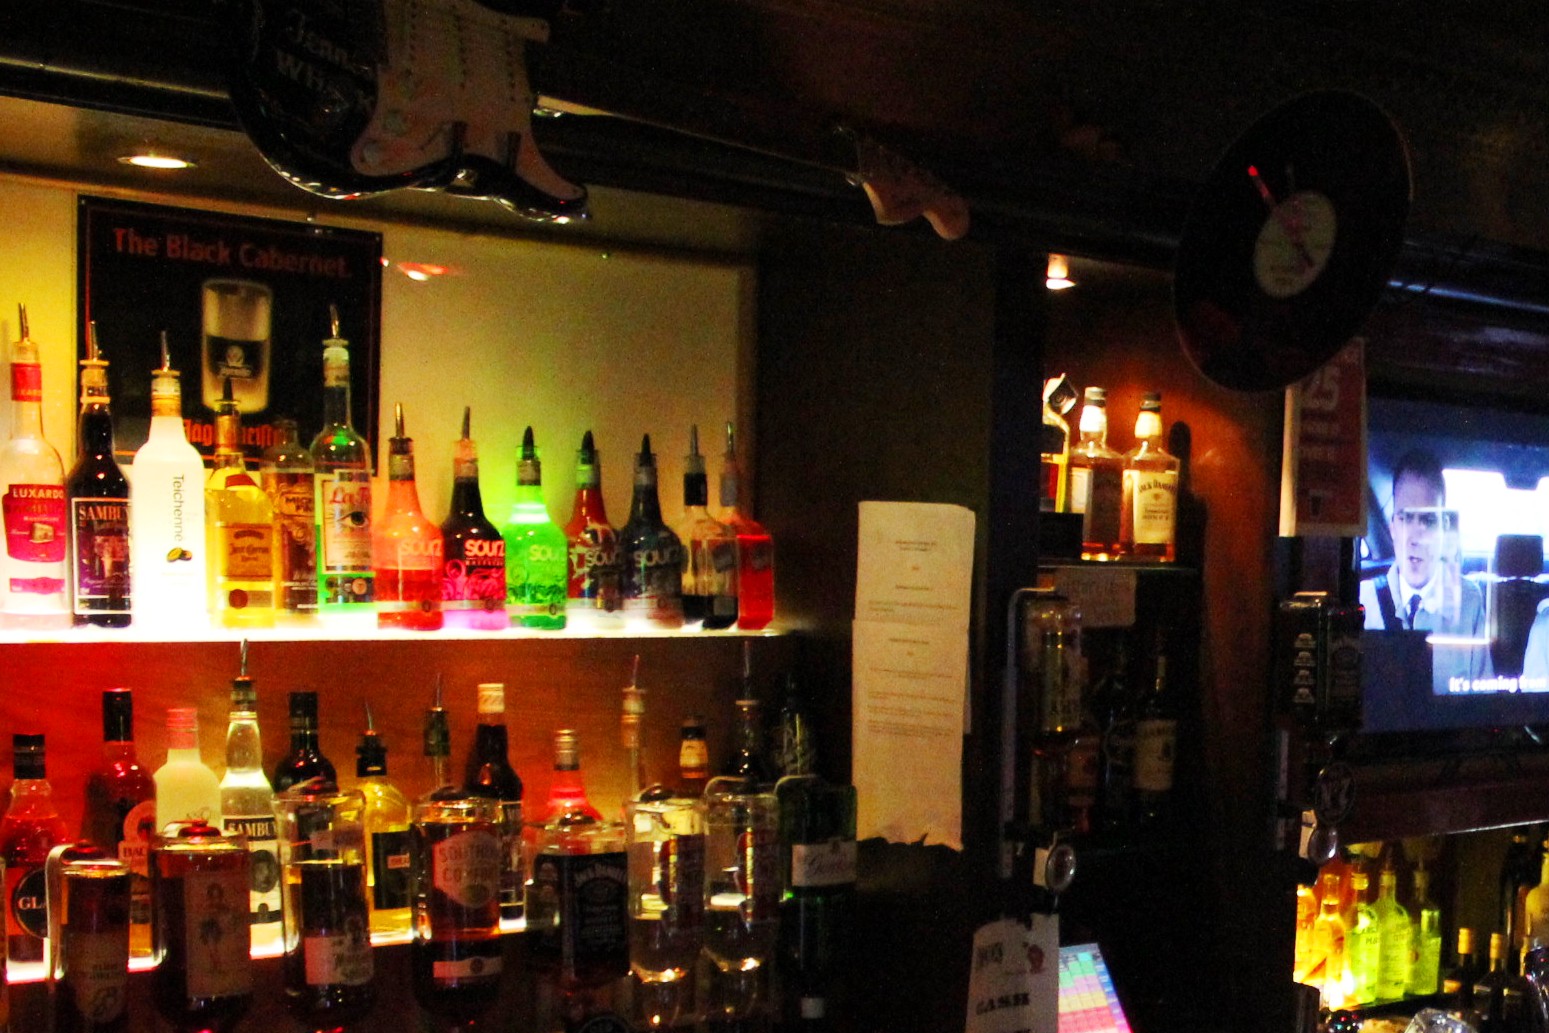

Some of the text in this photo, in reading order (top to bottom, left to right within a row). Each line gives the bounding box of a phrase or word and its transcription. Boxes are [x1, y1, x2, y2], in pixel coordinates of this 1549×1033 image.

[113, 228, 158, 256] The
[165, 233, 231, 266] Black
[12, 487, 65, 500] LUXARDO
[172, 474, 185, 542] Teichenne
[1471, 675, 1518, 693] coming
